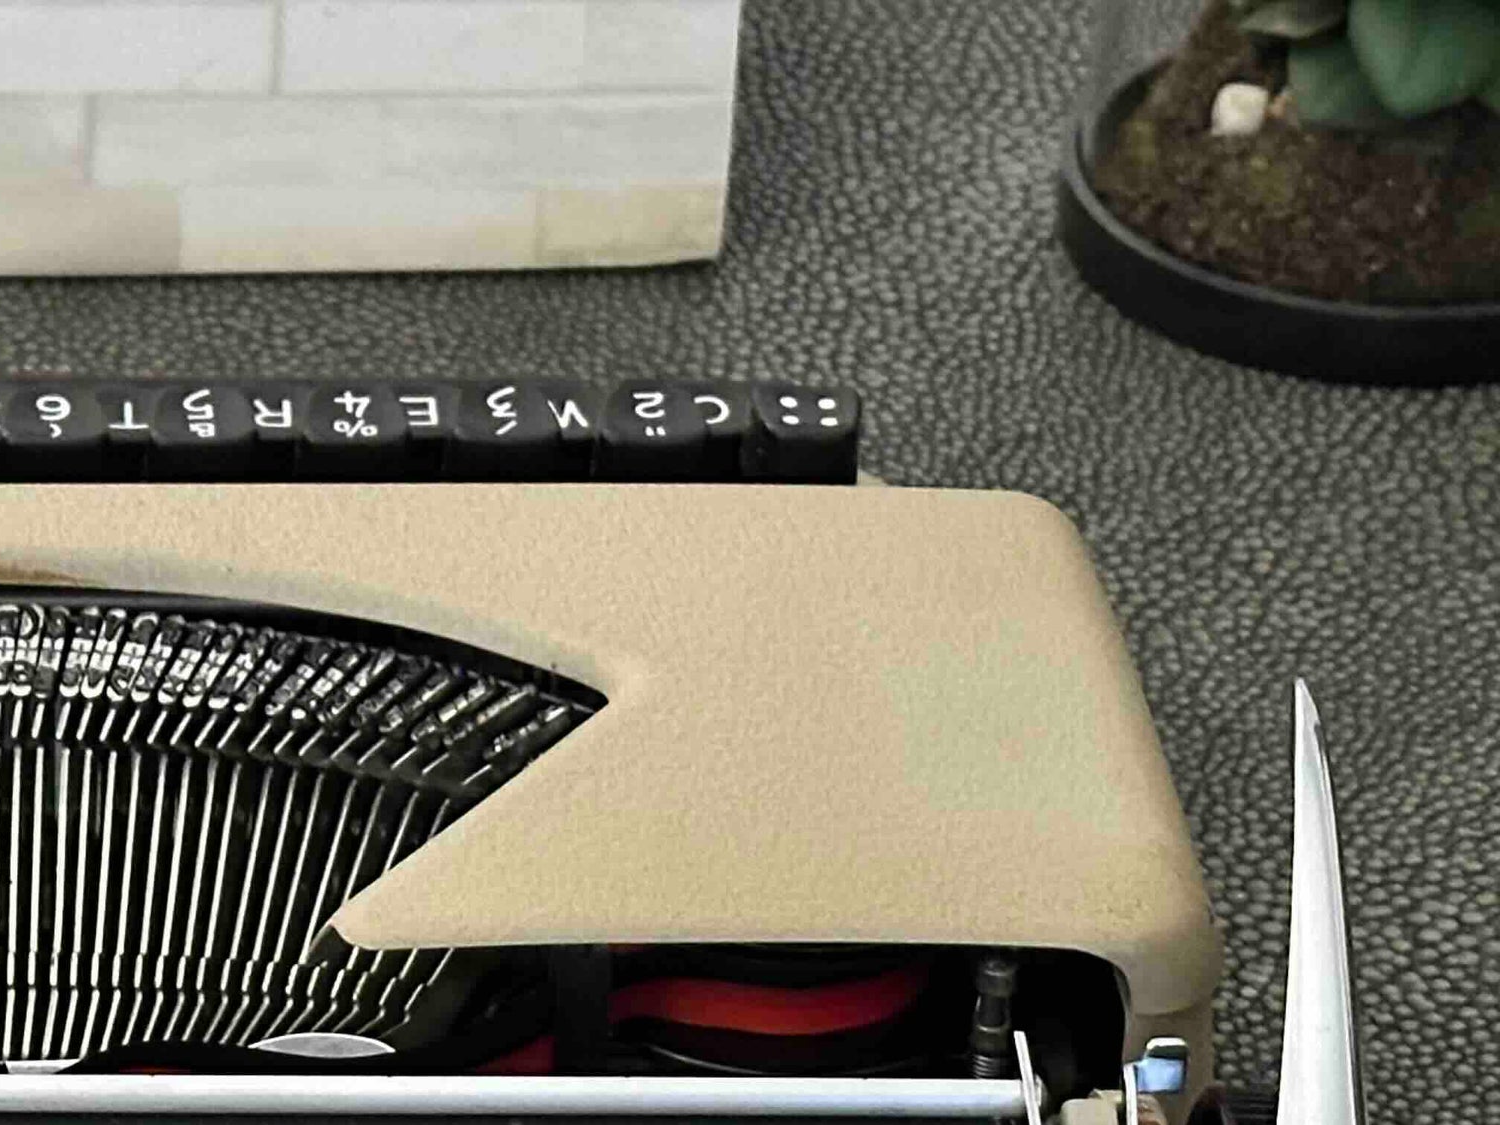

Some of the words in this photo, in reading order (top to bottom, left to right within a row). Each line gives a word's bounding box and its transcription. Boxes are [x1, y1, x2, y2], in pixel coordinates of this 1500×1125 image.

[35, 394, 72, 422] 6
[108, 401, 150, 430] T
[182, 388, 215, 420] 5
[253, 398, 293, 429] R
[333, 390, 372, 418] 4
[398, 396, 440, 427] E
[486, 386, 518, 418] 3
[632, 391, 666, 419] 2
